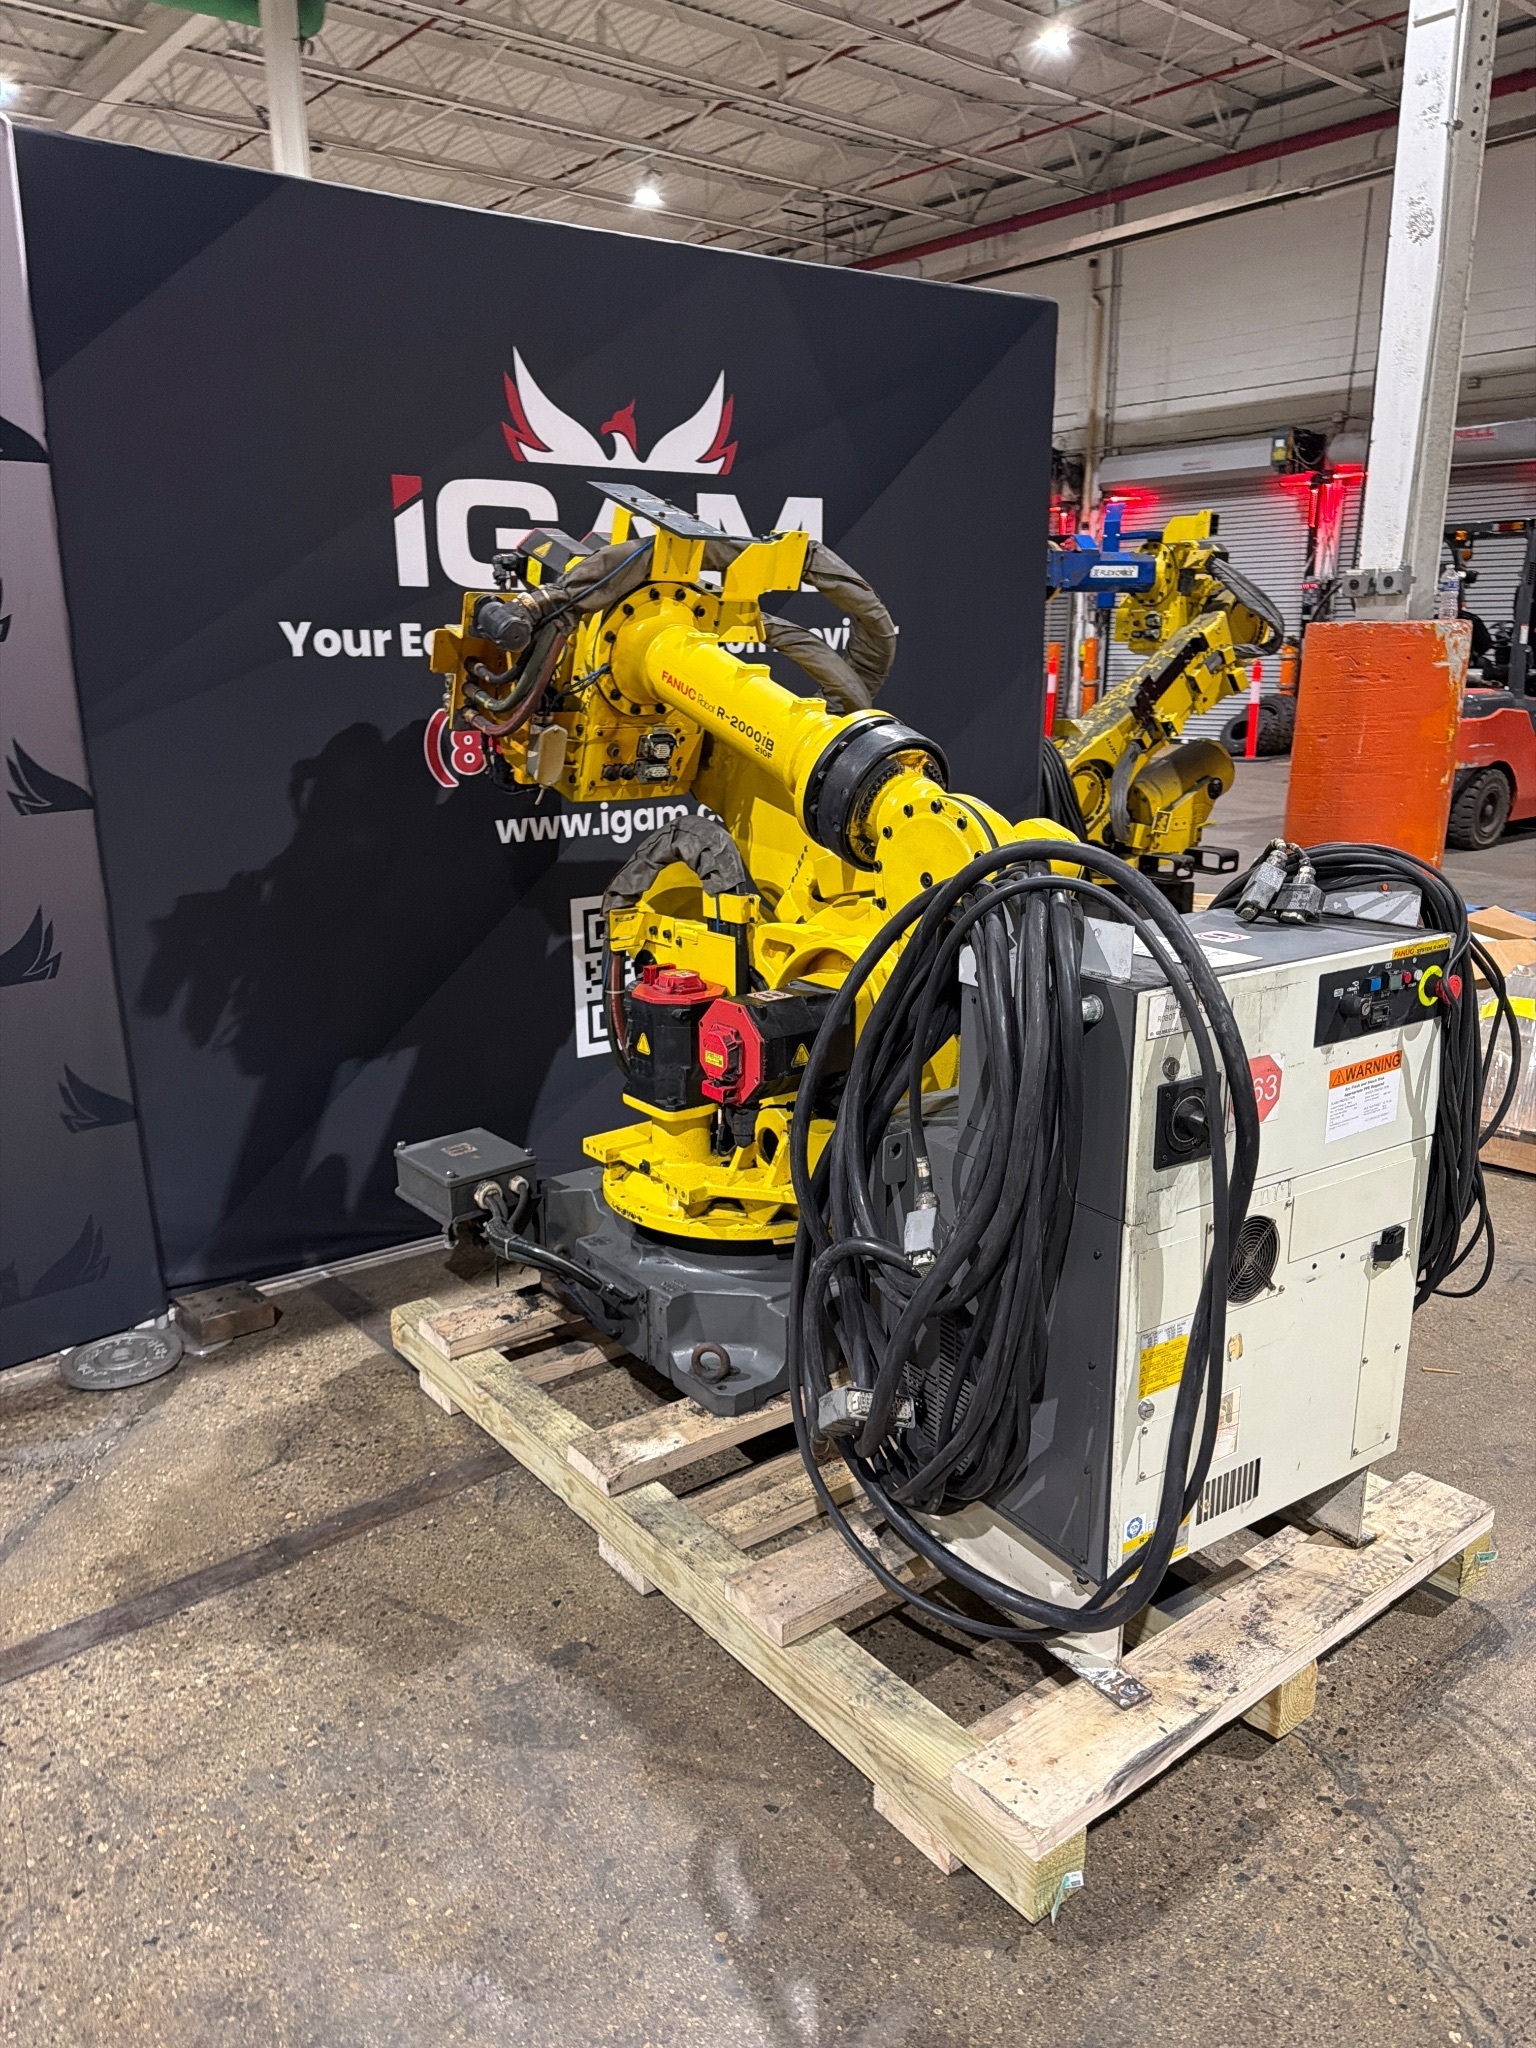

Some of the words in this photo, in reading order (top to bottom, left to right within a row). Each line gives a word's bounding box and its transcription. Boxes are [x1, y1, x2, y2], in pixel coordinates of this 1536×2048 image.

[391, 473, 824, 592] iGM
[278, 621, 392, 657] Your
[661, 670, 696, 700] FANUC
[697, 693, 715, 713] Robot
[754, 744, 772, 759] 210F
[1393, 947, 1415, 958] FANUC
[1345, 1053, 1401, 1081] WARNING
